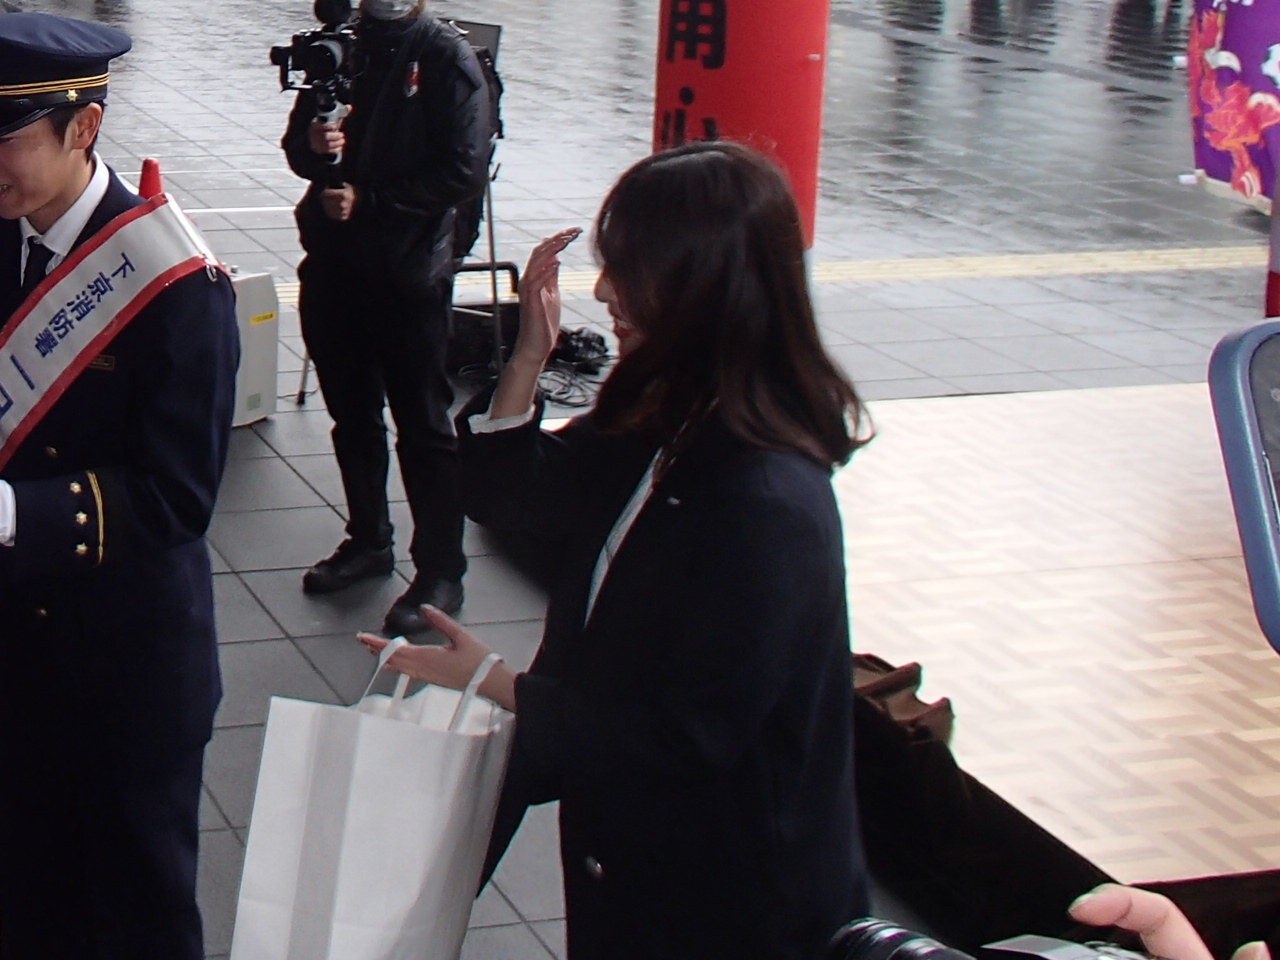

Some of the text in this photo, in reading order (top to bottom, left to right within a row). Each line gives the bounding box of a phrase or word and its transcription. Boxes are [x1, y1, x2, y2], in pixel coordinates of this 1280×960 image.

[33, 252, 135, 358] 下京消防署
